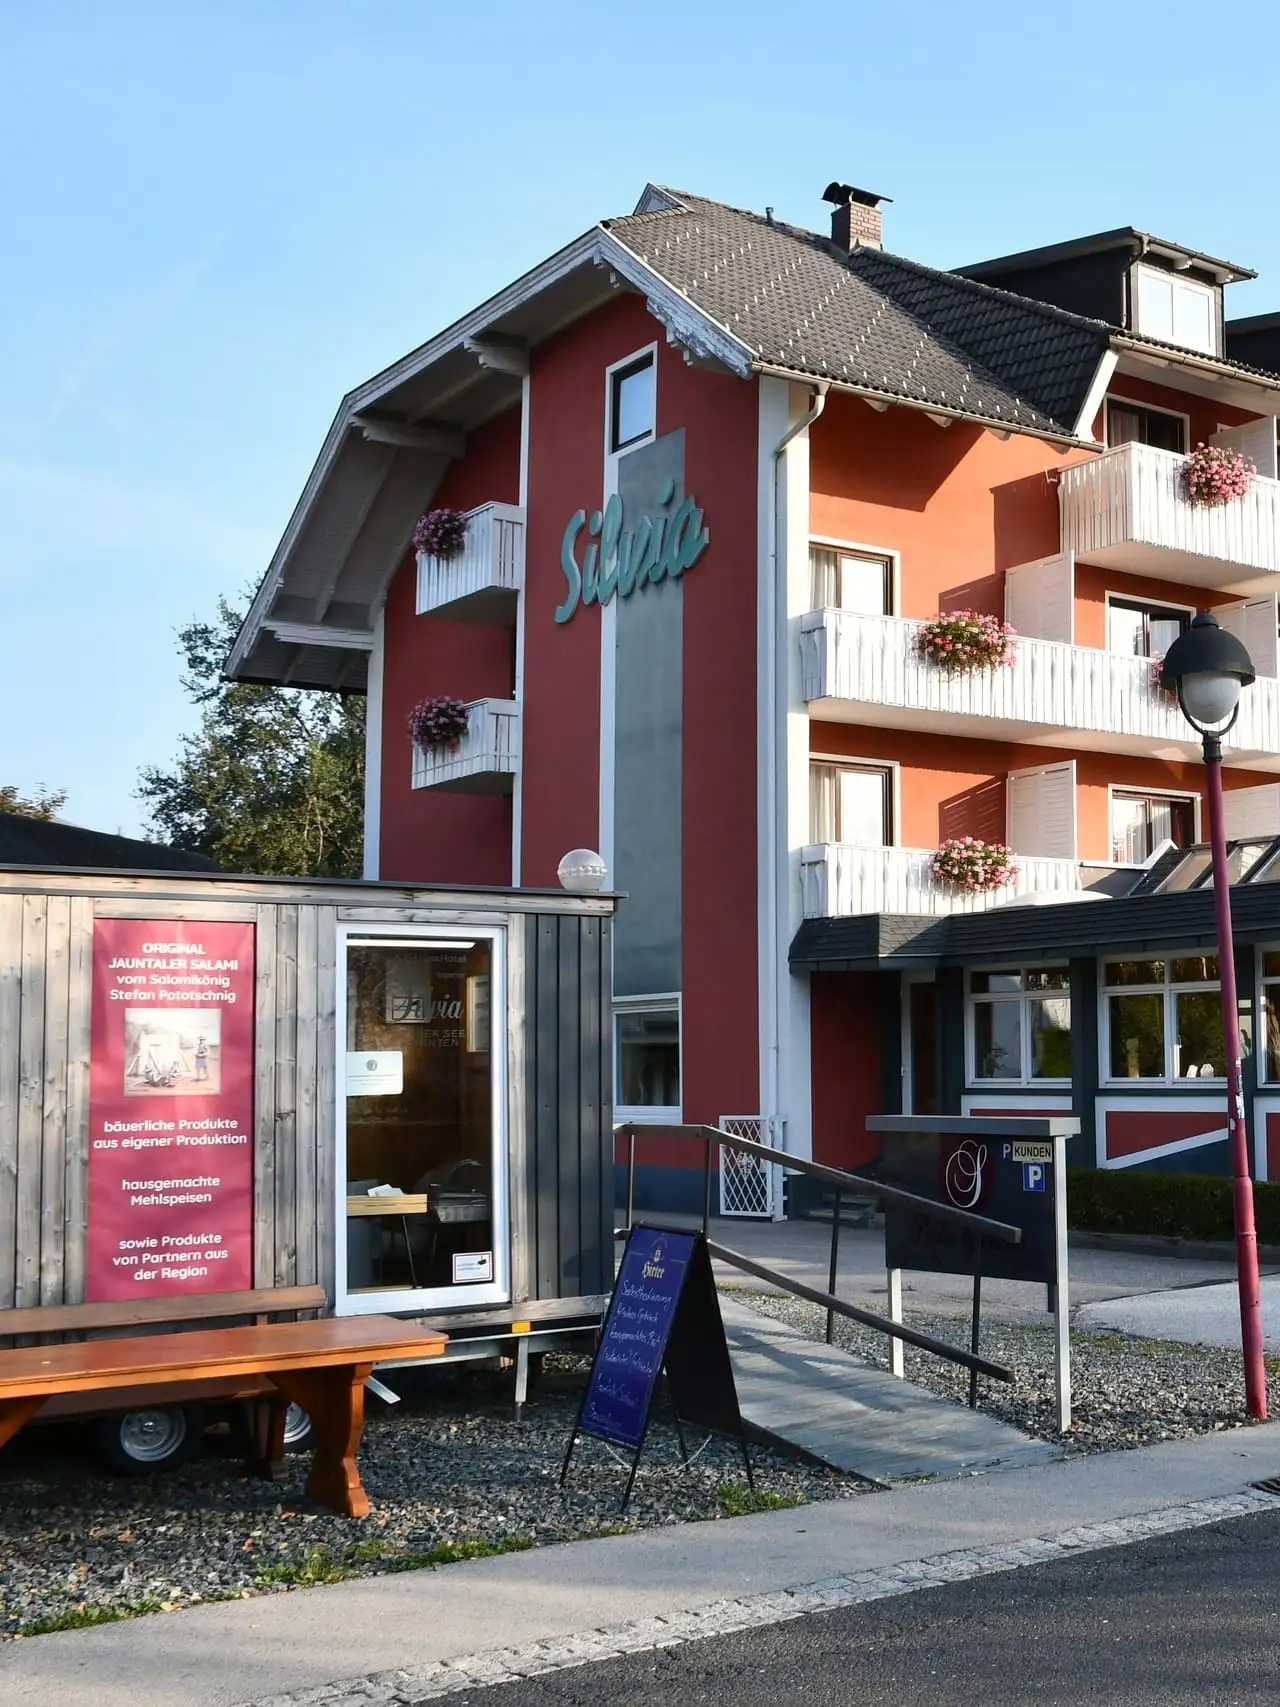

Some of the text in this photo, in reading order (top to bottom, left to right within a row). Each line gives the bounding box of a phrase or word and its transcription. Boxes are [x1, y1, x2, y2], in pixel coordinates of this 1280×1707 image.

[554, 477, 709, 623] Silvia
[142, 942, 207, 955] ORIGINAL
[108, 957, 239, 970] JAUNTALER SALAMI
[116, 973, 231, 988] vom Salamikönig
[110, 989, 237, 1003] Stefan Pototschnig
[104, 1118, 239, 1132] bäuerliche Produkte
[93, 1133, 247, 1150] aus eigener Produktion
[1002, 1143, 1012, 1159] P
[1013, 1145, 1051, 1158] KUNDEN
[121, 1176, 221, 1191] hausgemachte
[1028, 1165, 1042, 1189] P
[130, 1192, 212, 1207] Mehlspeisen
[119, 1233, 222, 1250] sowie Produkte
[112, 1248, 229, 1266] von Partnern aus
[133, 1266, 208, 1281] der Region
